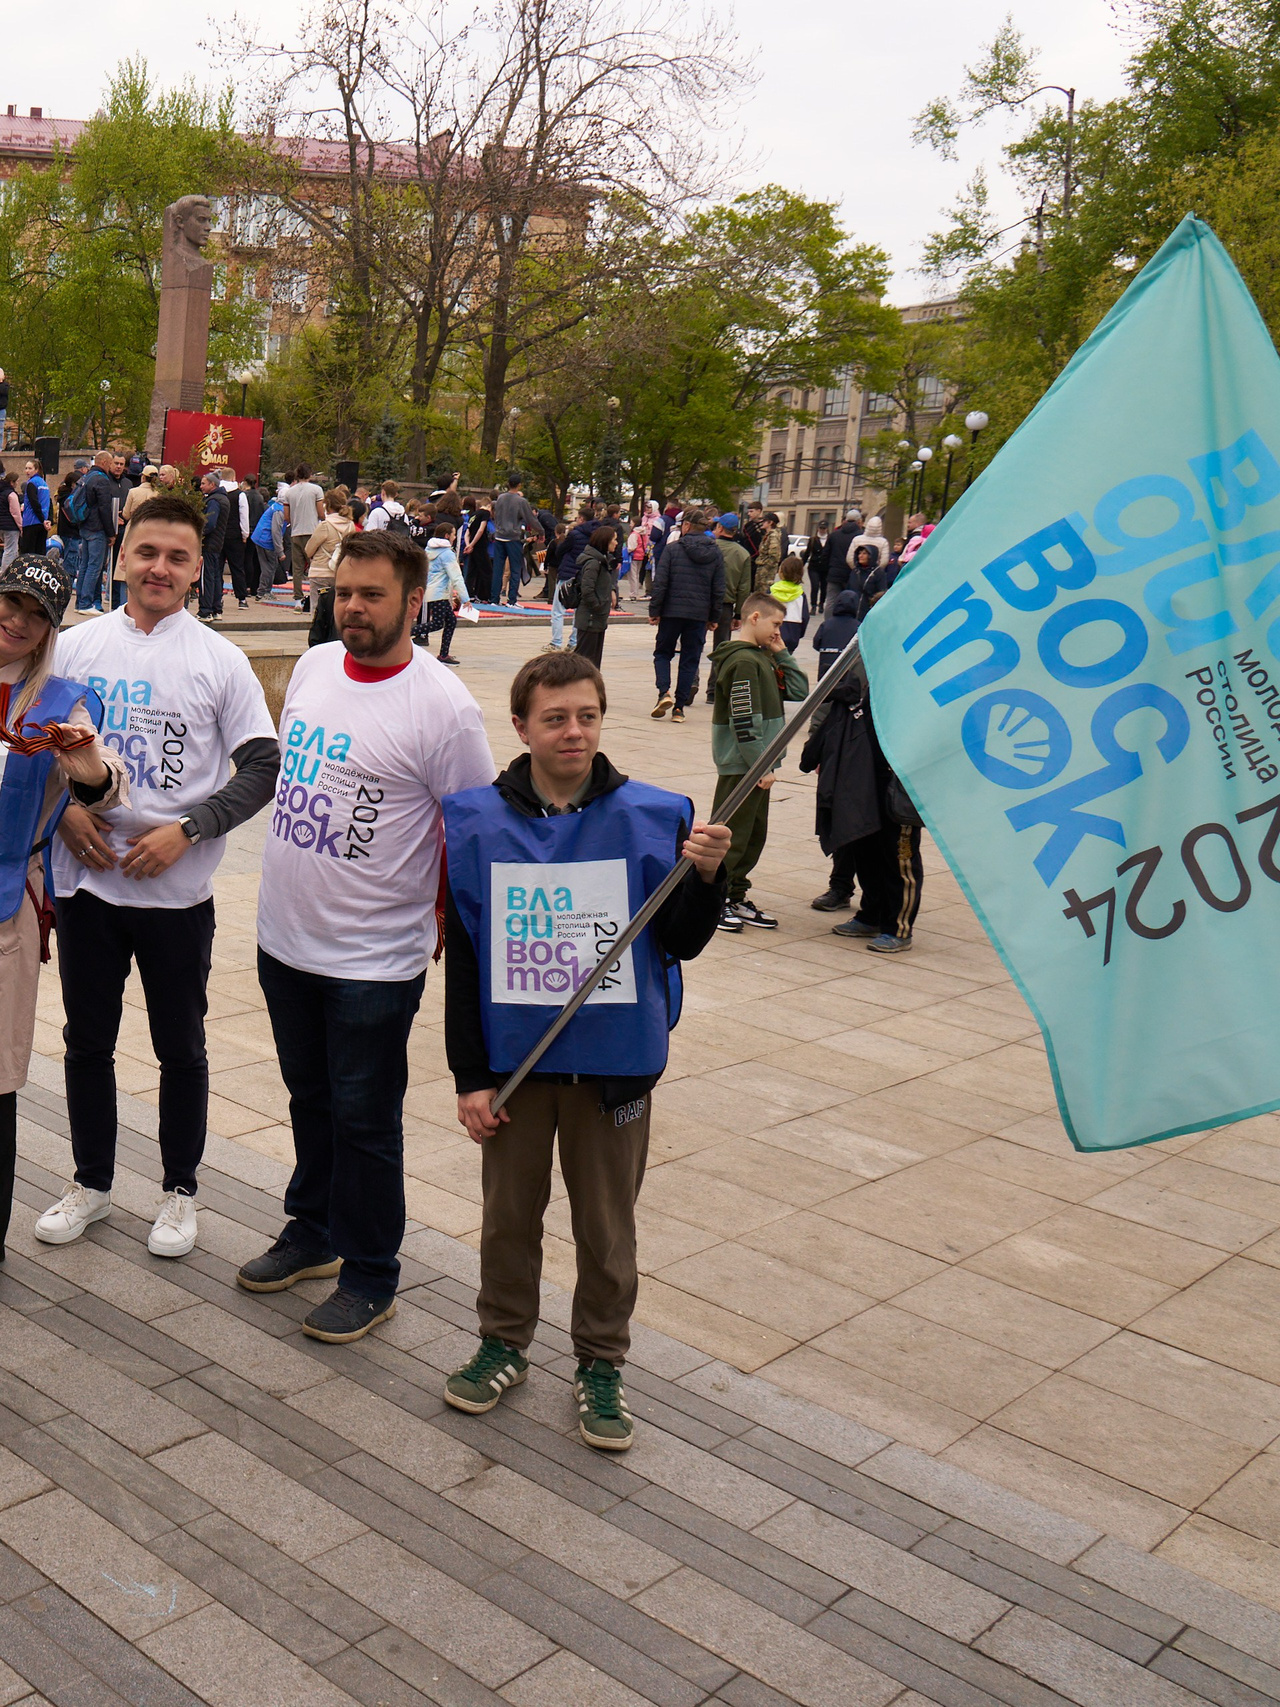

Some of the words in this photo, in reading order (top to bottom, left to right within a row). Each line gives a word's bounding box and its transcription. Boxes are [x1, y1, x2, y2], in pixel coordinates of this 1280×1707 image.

[210, 454, 228, 465] МАЯ
[25, 567, 61, 594] GUCCI
[981, 518, 1191, 785] вос
[88, 676, 152, 706] вла
[130, 716, 162, 726] столица
[131, 707, 181, 719] молодёжная
[730, 680, 756, 743] PUMA
[1185, 666, 1237, 780] России
[1217, 660, 1279, 784] столица
[129, 724, 157, 735] России
[287, 719, 352, 762] вла
[902, 581, 1126, 888] ток
[103, 733, 147, 761] ос
[160, 721, 187, 791] 2024
[321, 772, 357, 789] столица
[325, 762, 380, 784] молодёжная
[277, 778, 332, 823] вос
[317, 781, 349, 797] России
[273, 807, 344, 858] ток
[343, 785, 384, 860] 2024
[507, 886, 573, 912] вла
[557, 911, 608, 921] молодёжная
[557, 922, 591, 930] столица
[557, 931, 587, 939] России
[507, 940, 578, 966] вос
[614, 1100, 645, 1127] GAP
